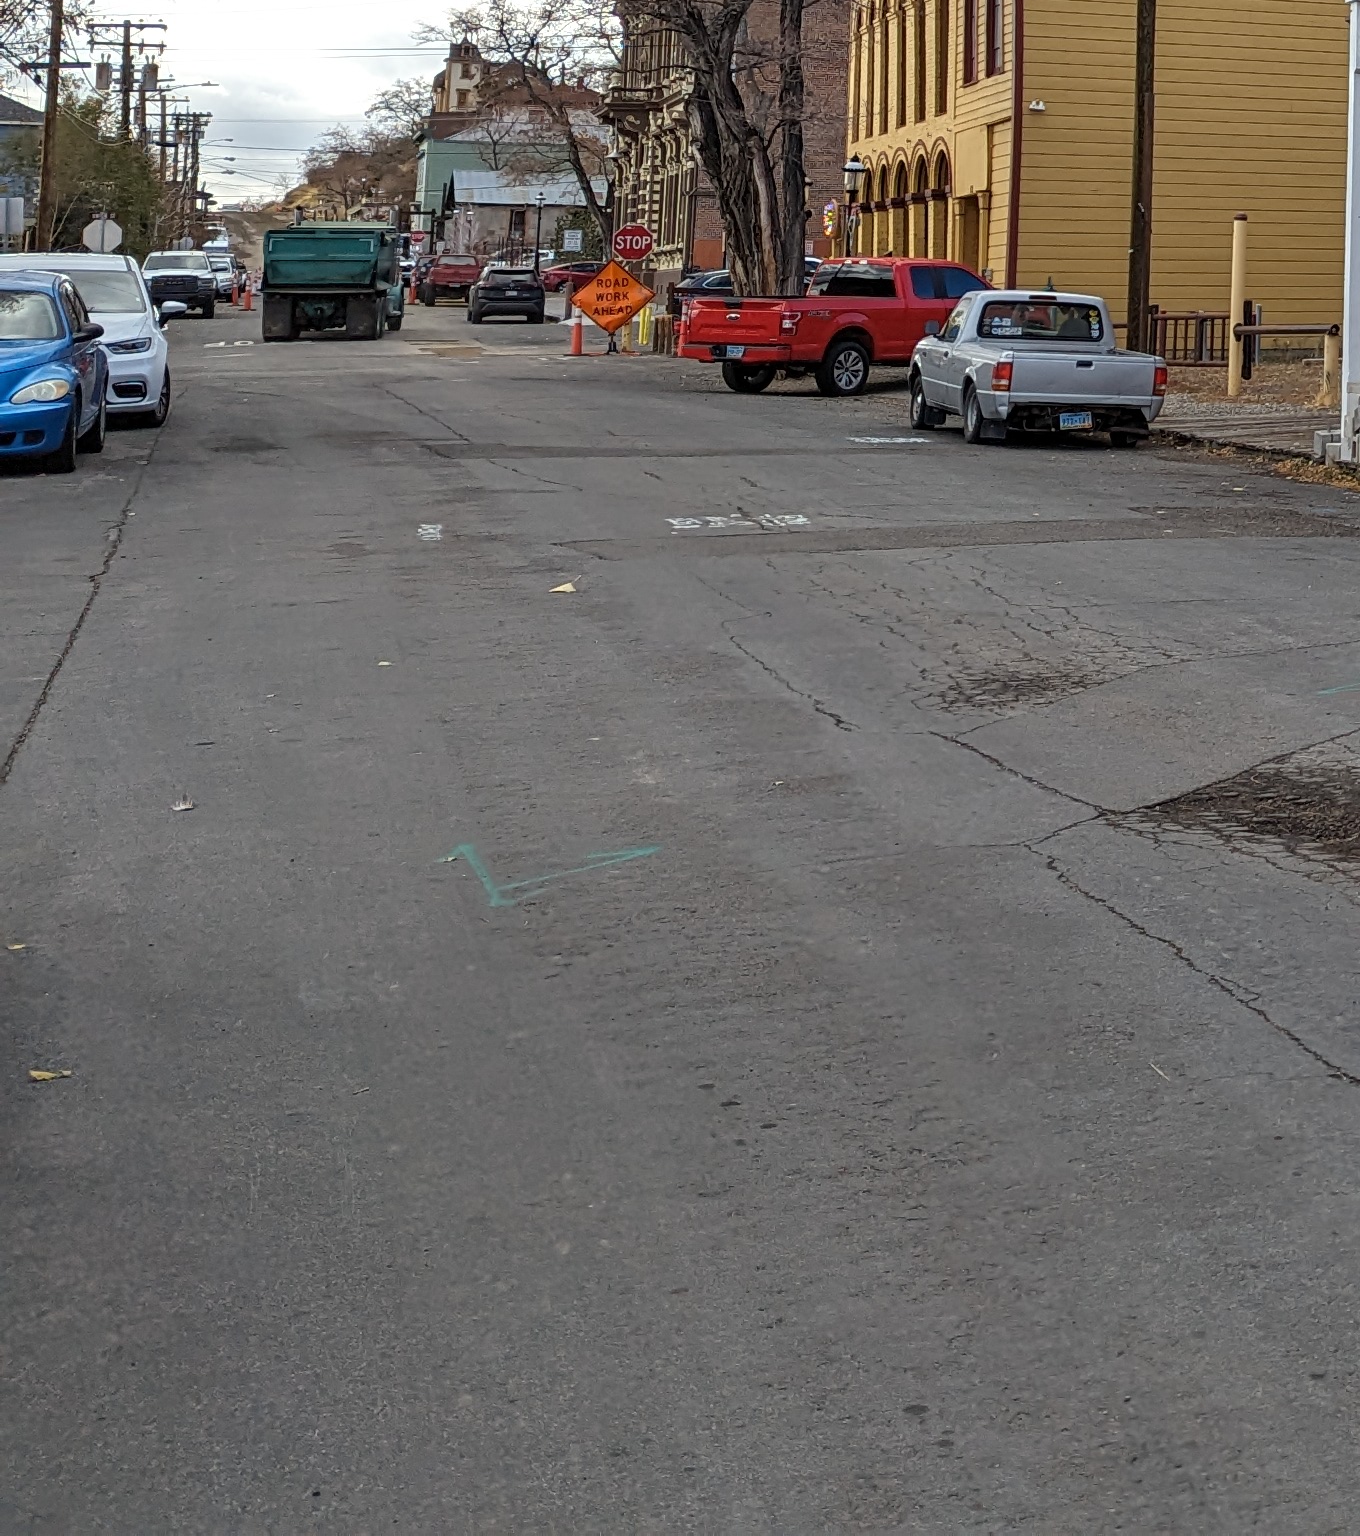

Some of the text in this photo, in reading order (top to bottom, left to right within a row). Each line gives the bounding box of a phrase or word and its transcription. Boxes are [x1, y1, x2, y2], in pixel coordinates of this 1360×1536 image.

[615, 236, 651, 250] STOP
[596, 278, 629, 288] ROAD
[596, 292, 630, 301] WORK
[593, 306, 632, 315] AHEAD
